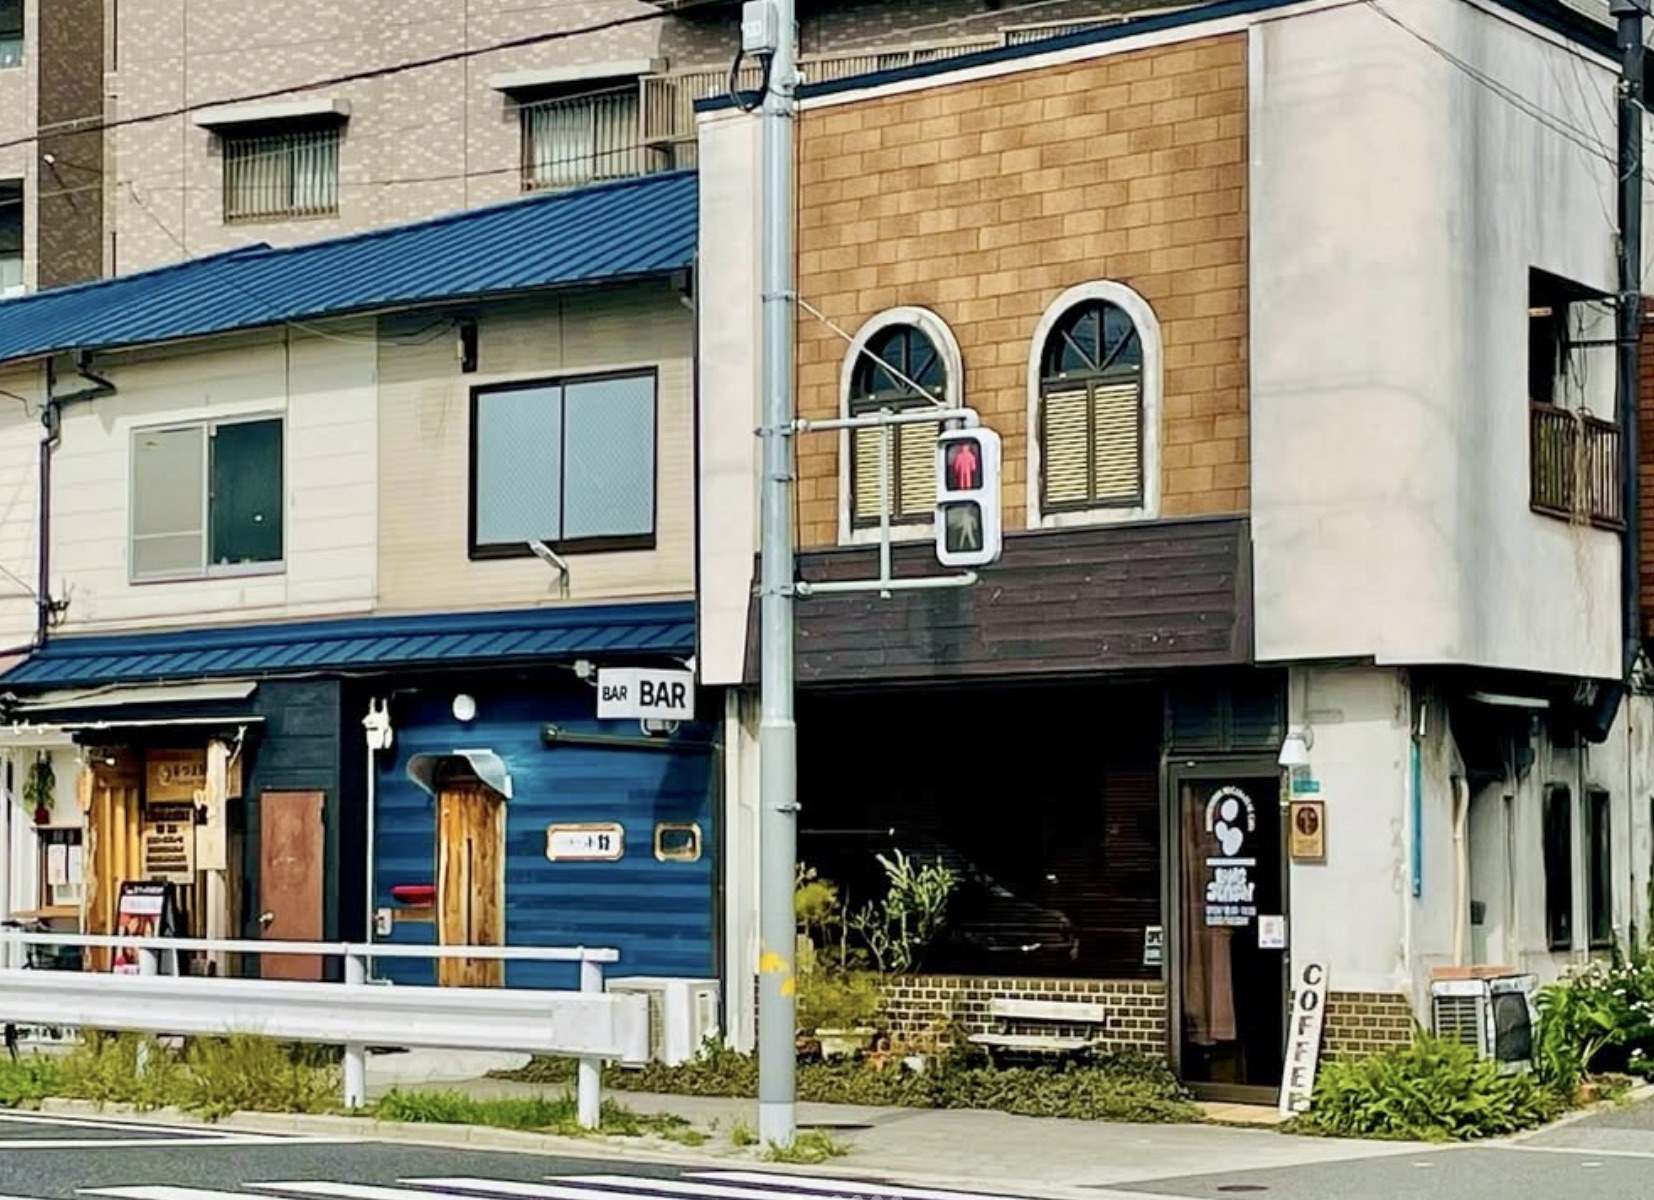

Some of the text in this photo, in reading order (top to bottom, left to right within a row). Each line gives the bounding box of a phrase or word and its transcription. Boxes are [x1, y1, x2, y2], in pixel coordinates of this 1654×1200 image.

[602, 684, 627, 701] BAR
[640, 680, 685, 708] BAR
[1287, 963, 1323, 1112] COFFEE
